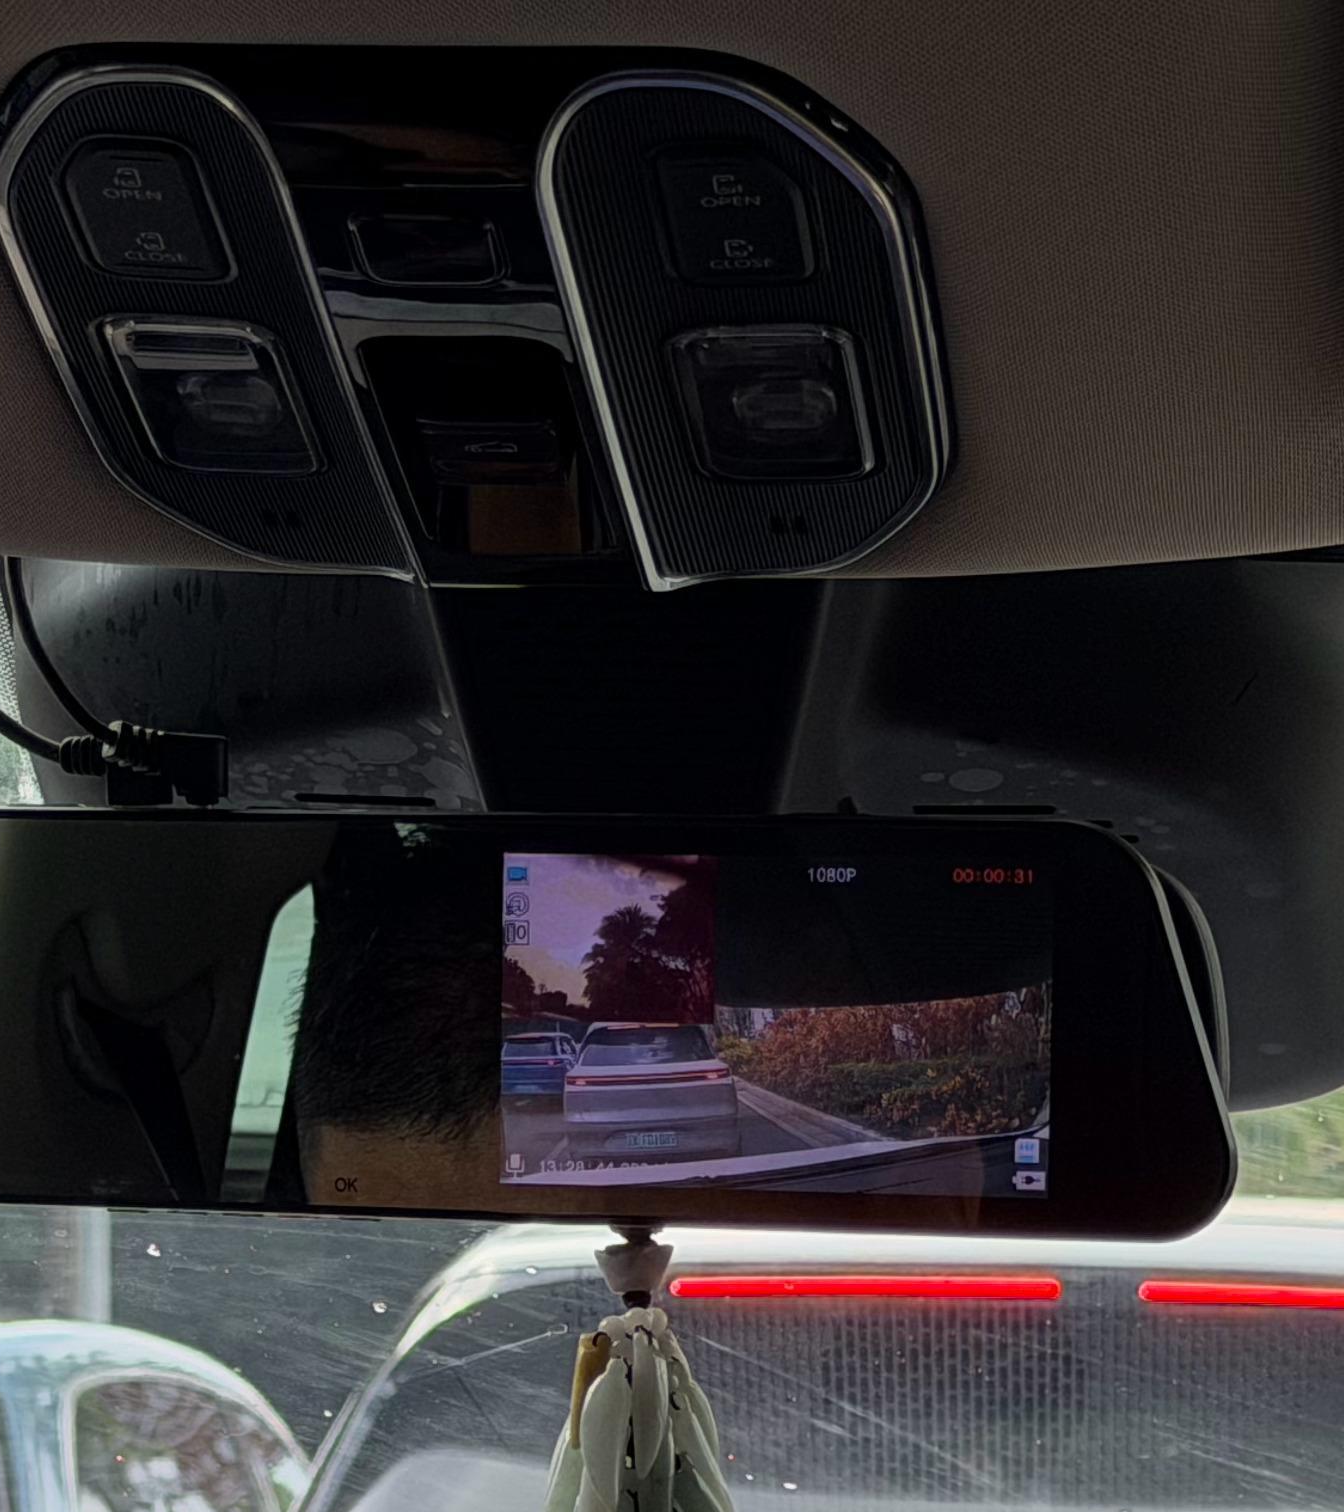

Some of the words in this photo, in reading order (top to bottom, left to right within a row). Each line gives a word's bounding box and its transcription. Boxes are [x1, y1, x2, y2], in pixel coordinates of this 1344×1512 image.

[102, 187, 163, 201] OPEN
[700, 194, 761, 208] OPEN
[806, 866, 857, 884] 1080P
[951, 867, 1034, 885] 00:00:31
[334, 1177, 358, 1193] OK
